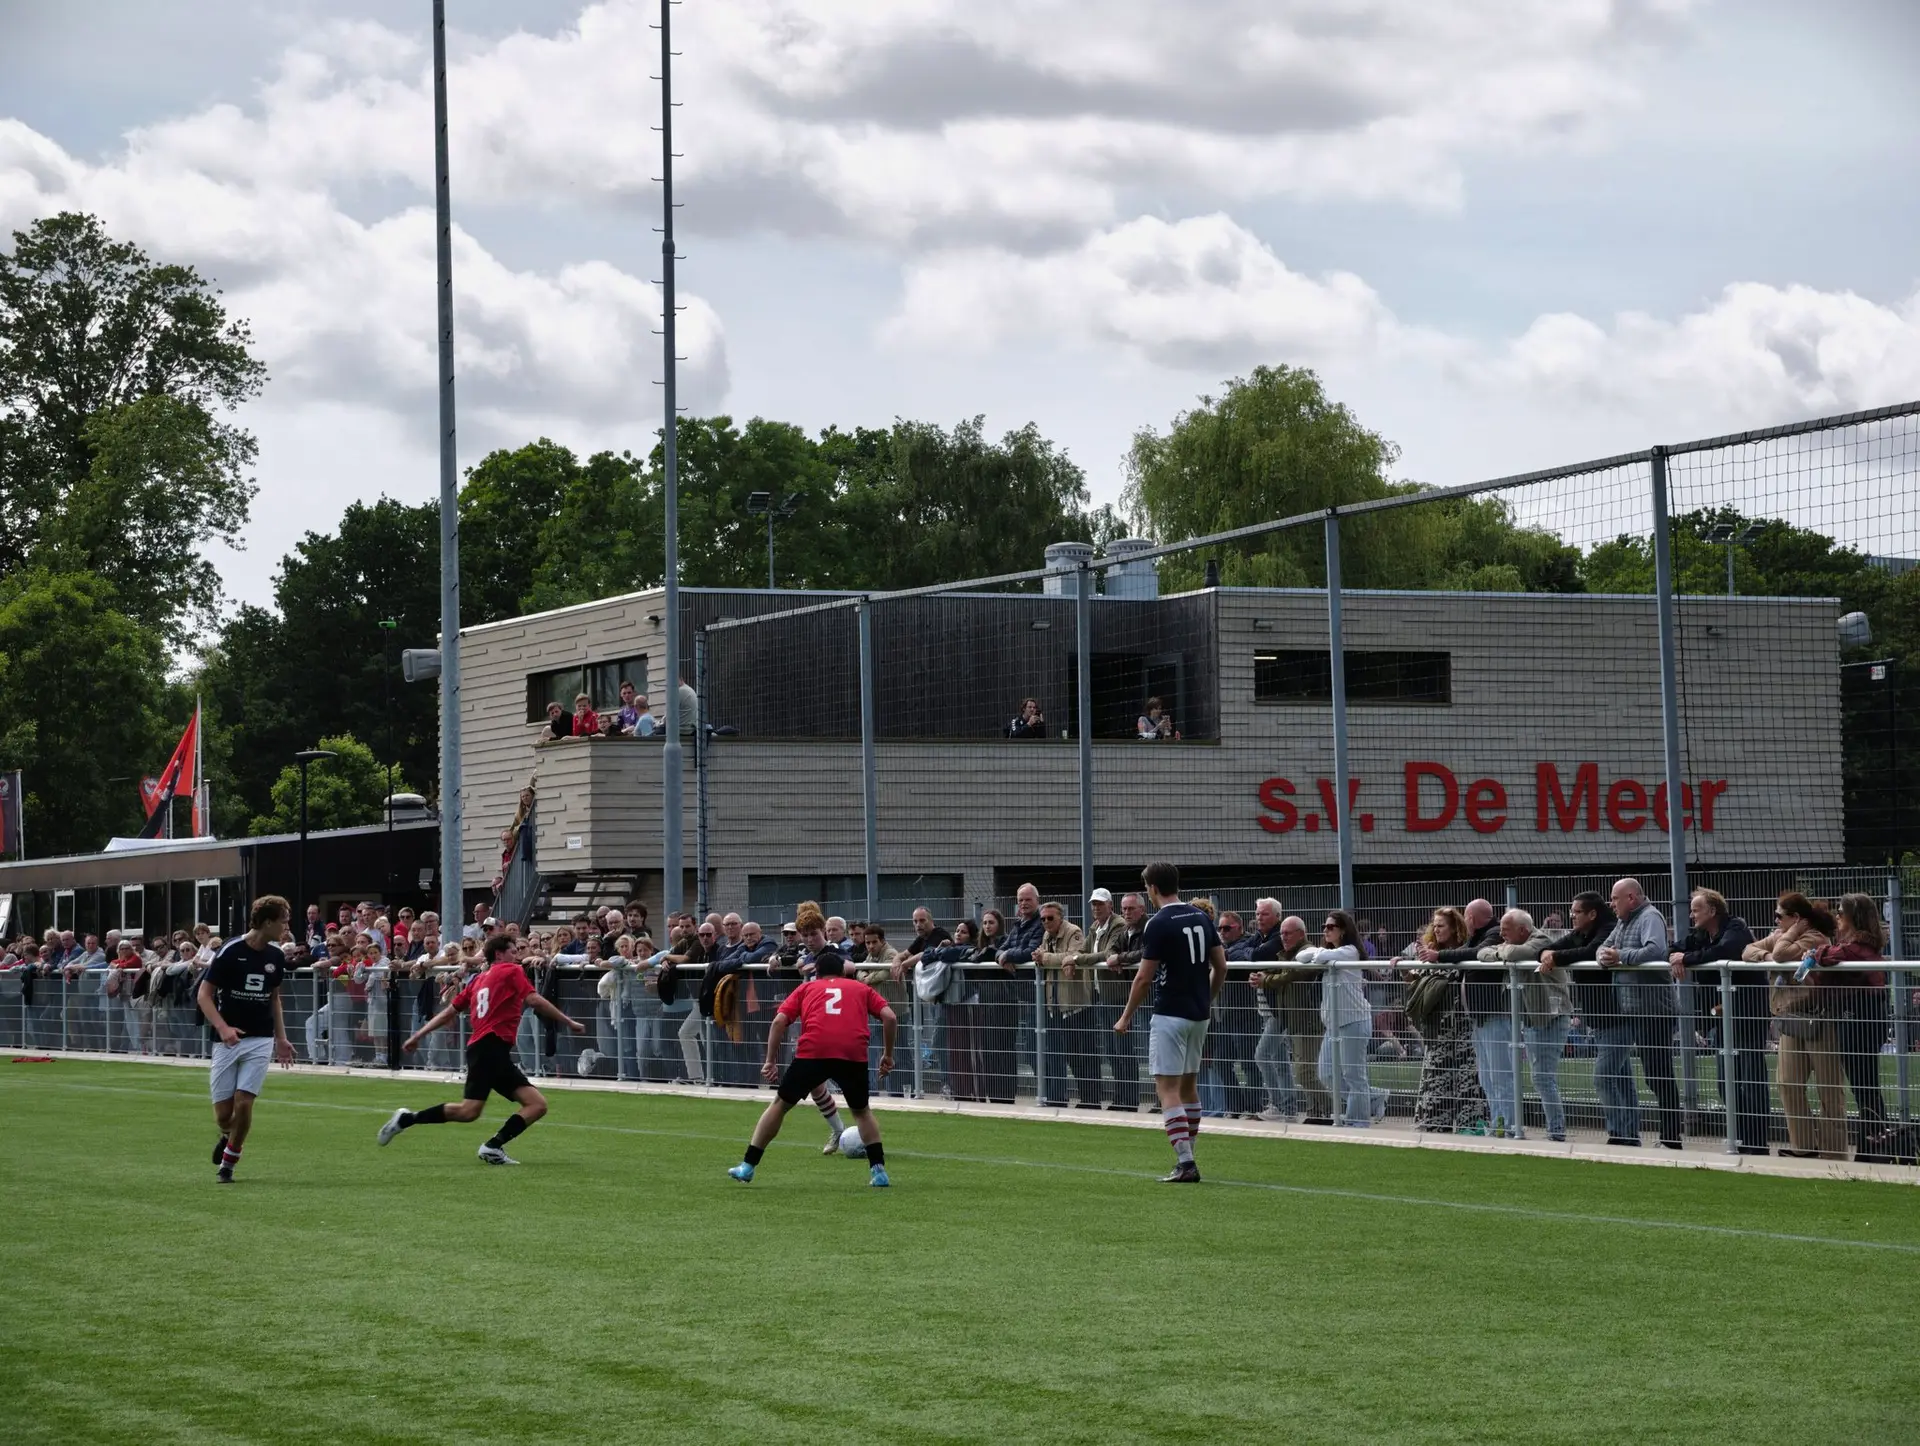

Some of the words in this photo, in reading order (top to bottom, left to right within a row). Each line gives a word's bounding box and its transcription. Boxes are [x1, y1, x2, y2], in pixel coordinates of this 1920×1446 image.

[1259, 778, 1372, 831] s.v.
[1406, 762, 1505, 831] De
[1538, 763, 1726, 831] Meer
[1182, 925, 1206, 965] 11
[244, 973, 265, 991] S
[476, 987, 490, 1019] 8
[825, 988, 842, 1015] 2
